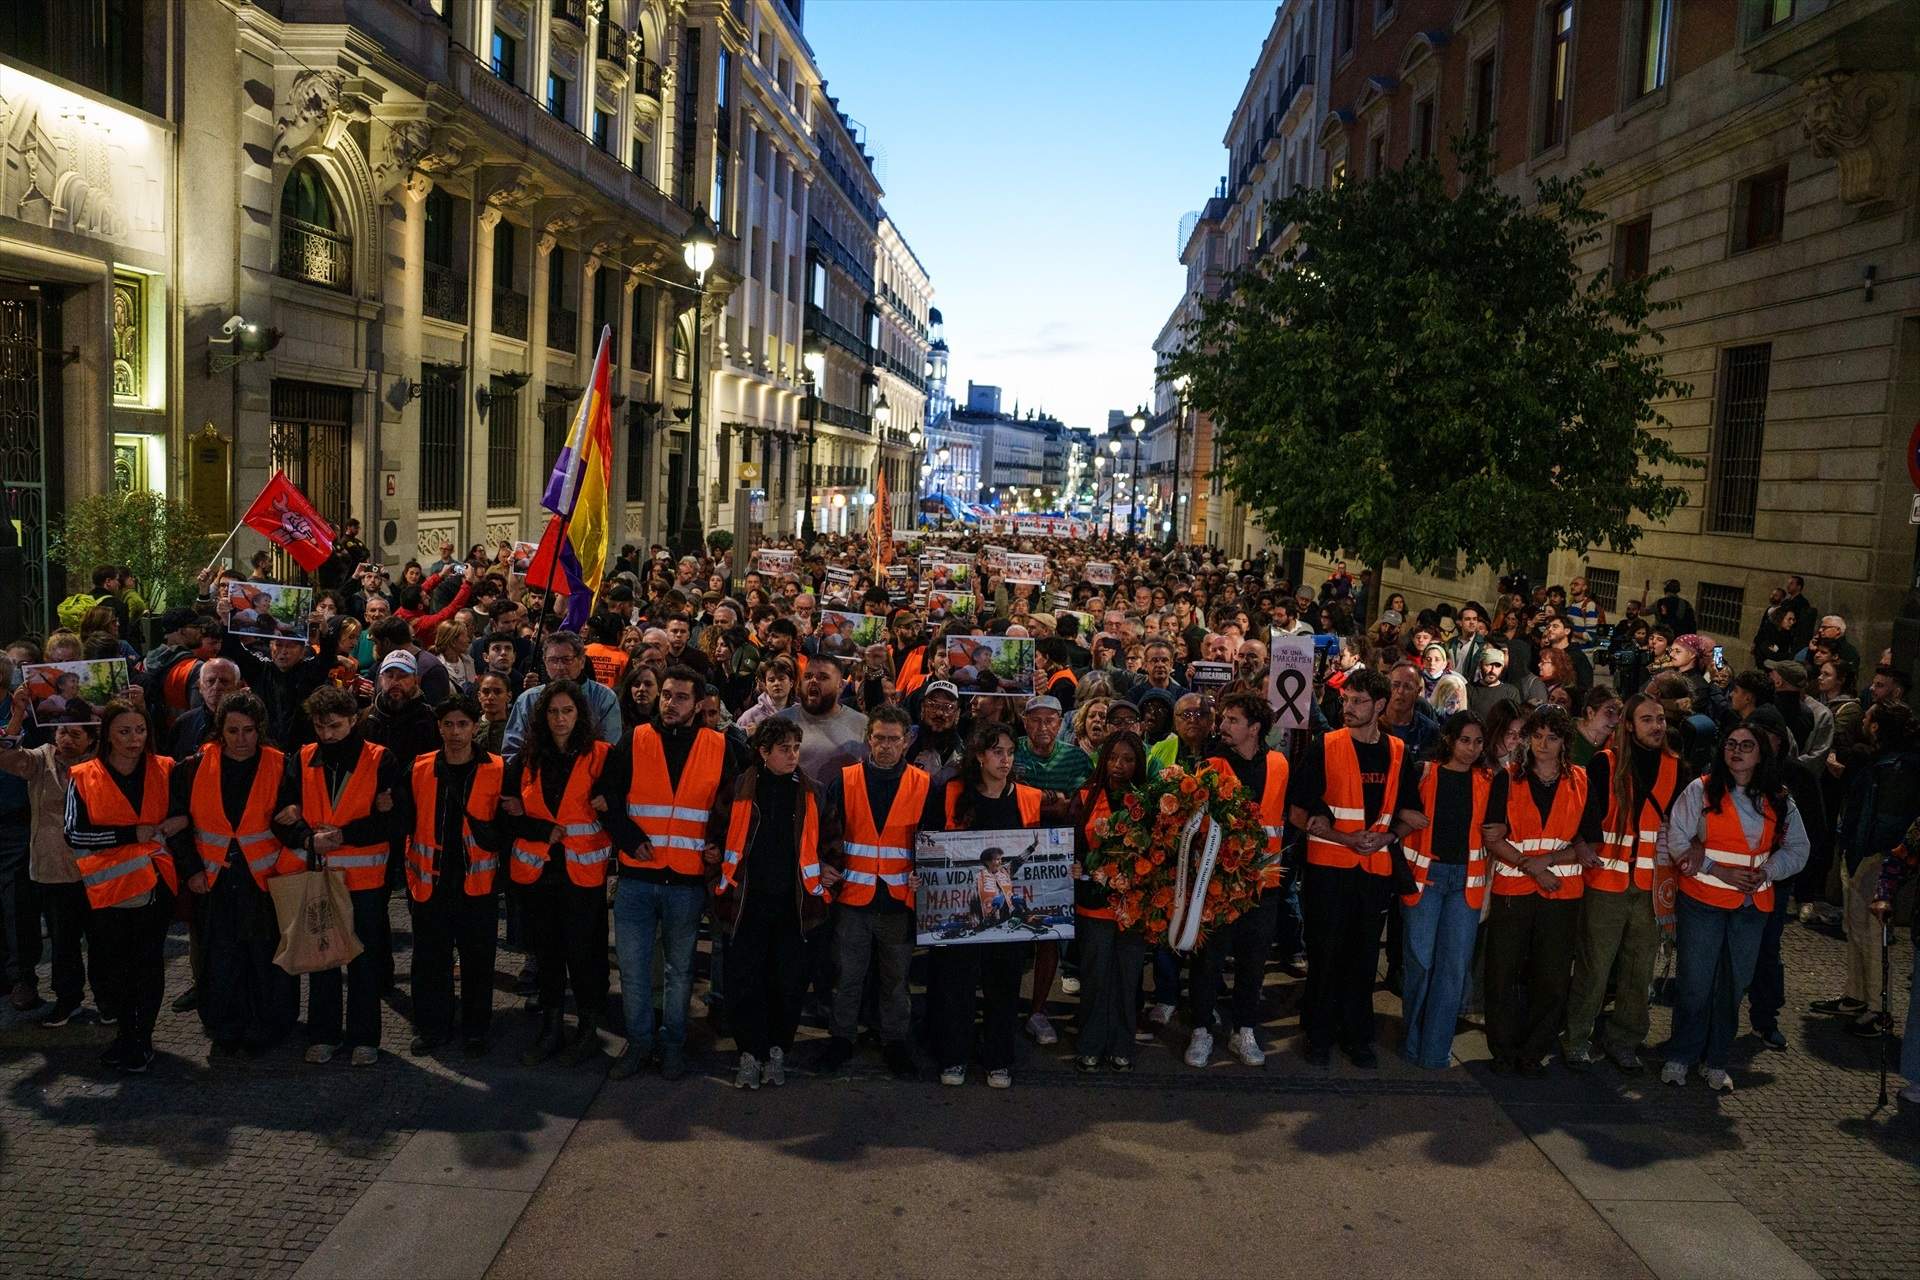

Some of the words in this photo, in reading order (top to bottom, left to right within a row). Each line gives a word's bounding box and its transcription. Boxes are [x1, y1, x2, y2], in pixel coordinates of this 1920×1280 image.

[1273, 654, 1312, 664] MARICARMEN
[946, 870, 975, 886] VIDA
[1024, 864, 1068, 881] BARRIO
[1032, 903, 1075, 918] ONTIGO
